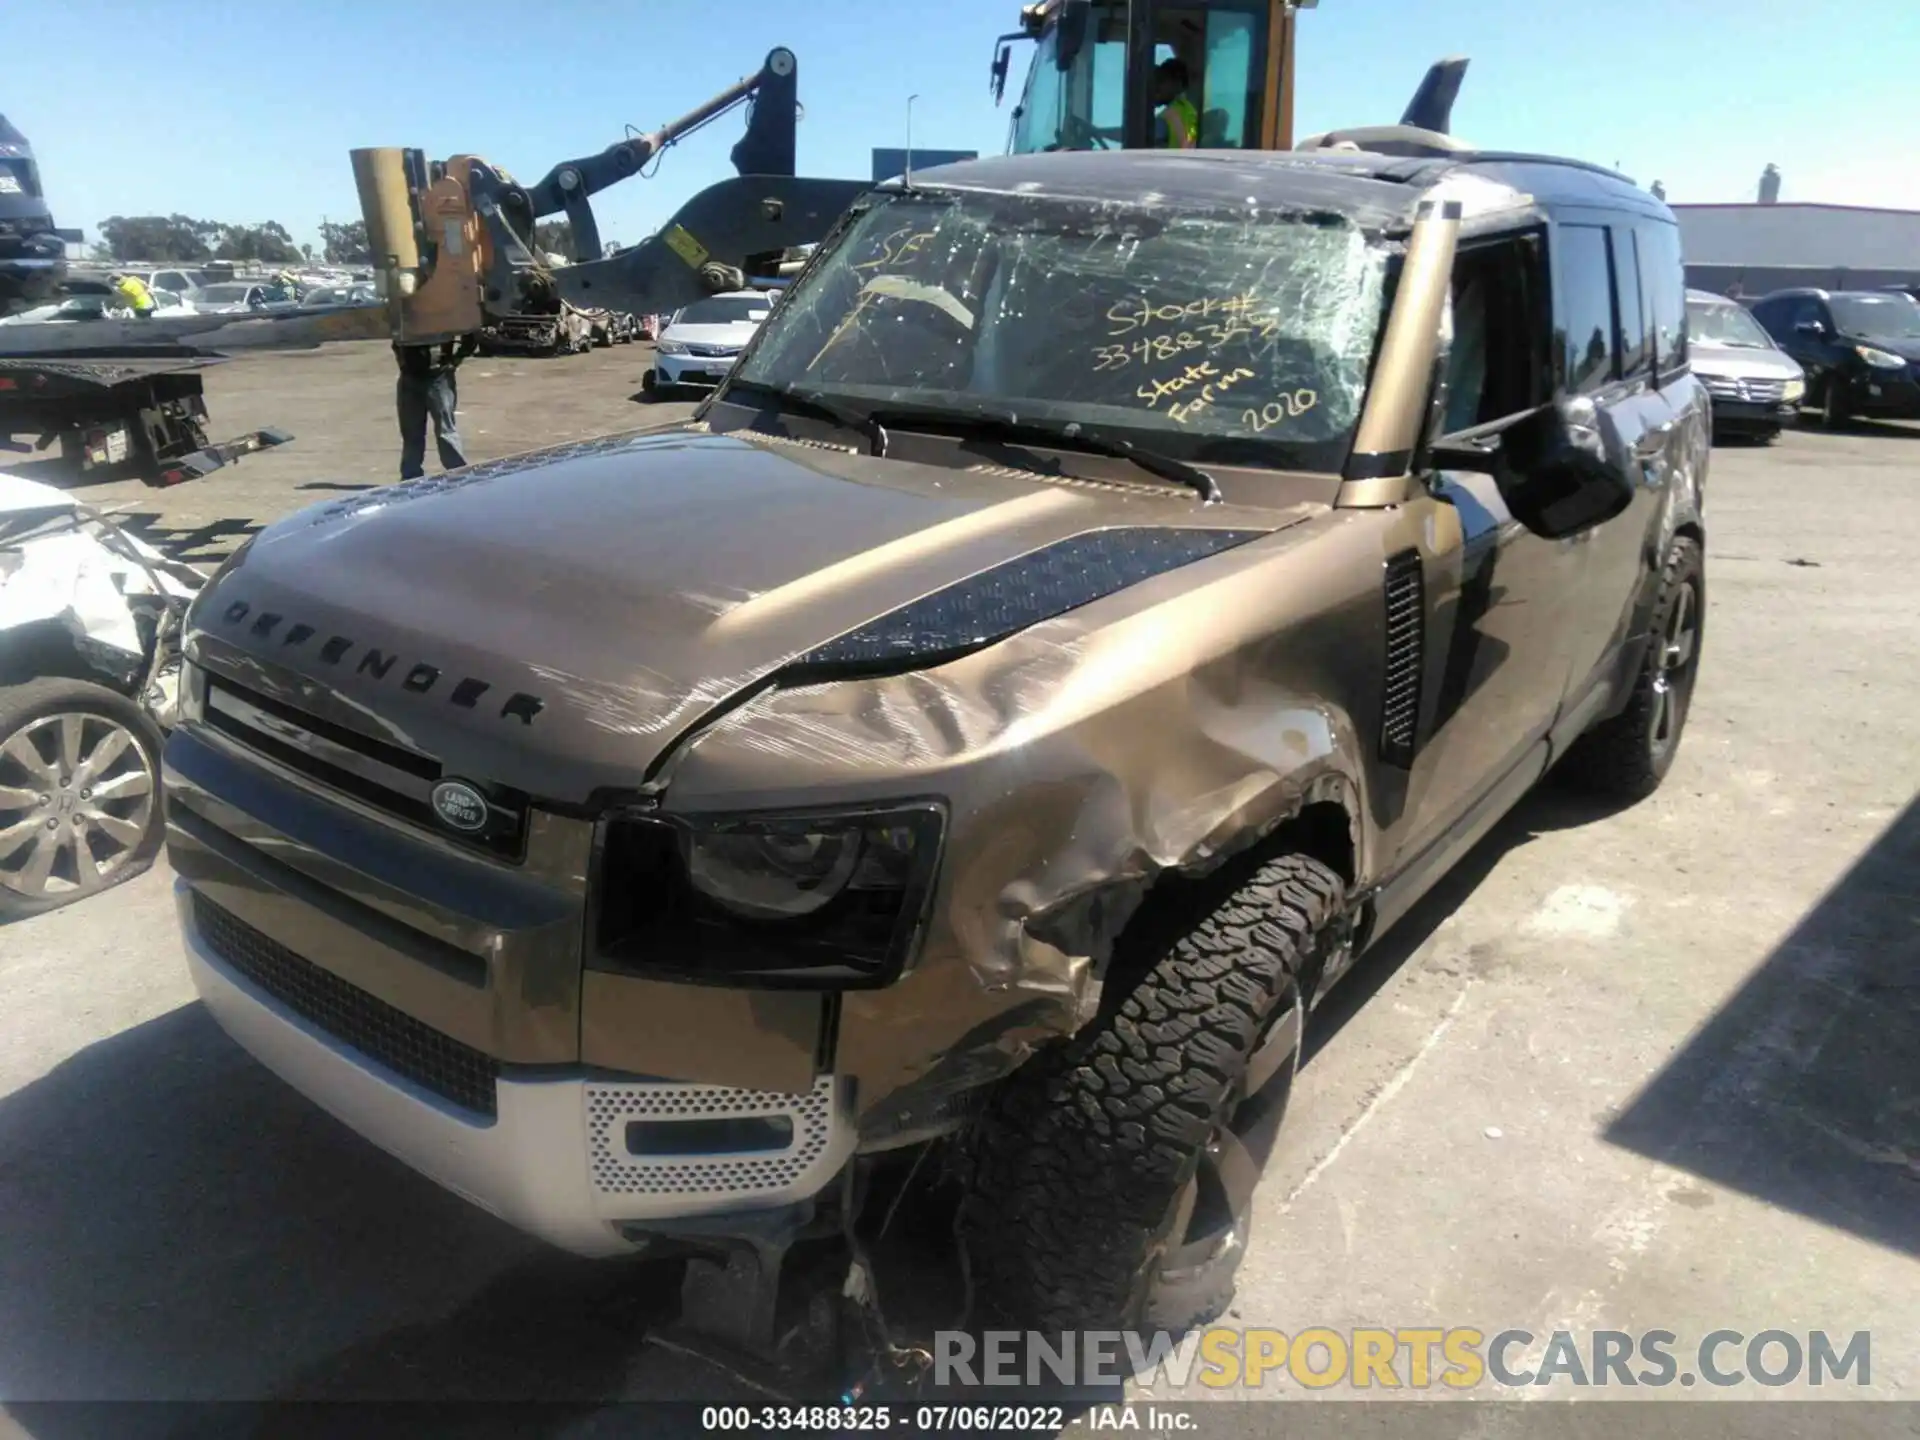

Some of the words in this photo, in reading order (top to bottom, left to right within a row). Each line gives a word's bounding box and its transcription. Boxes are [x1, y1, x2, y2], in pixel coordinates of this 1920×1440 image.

[1137, 361, 1220, 408] State
[1242, 388, 1317, 432] 2020
[224, 601, 545, 725] DEFENDER
[444, 791, 470, 807] LAND
[446, 803, 476, 821] ROVER
